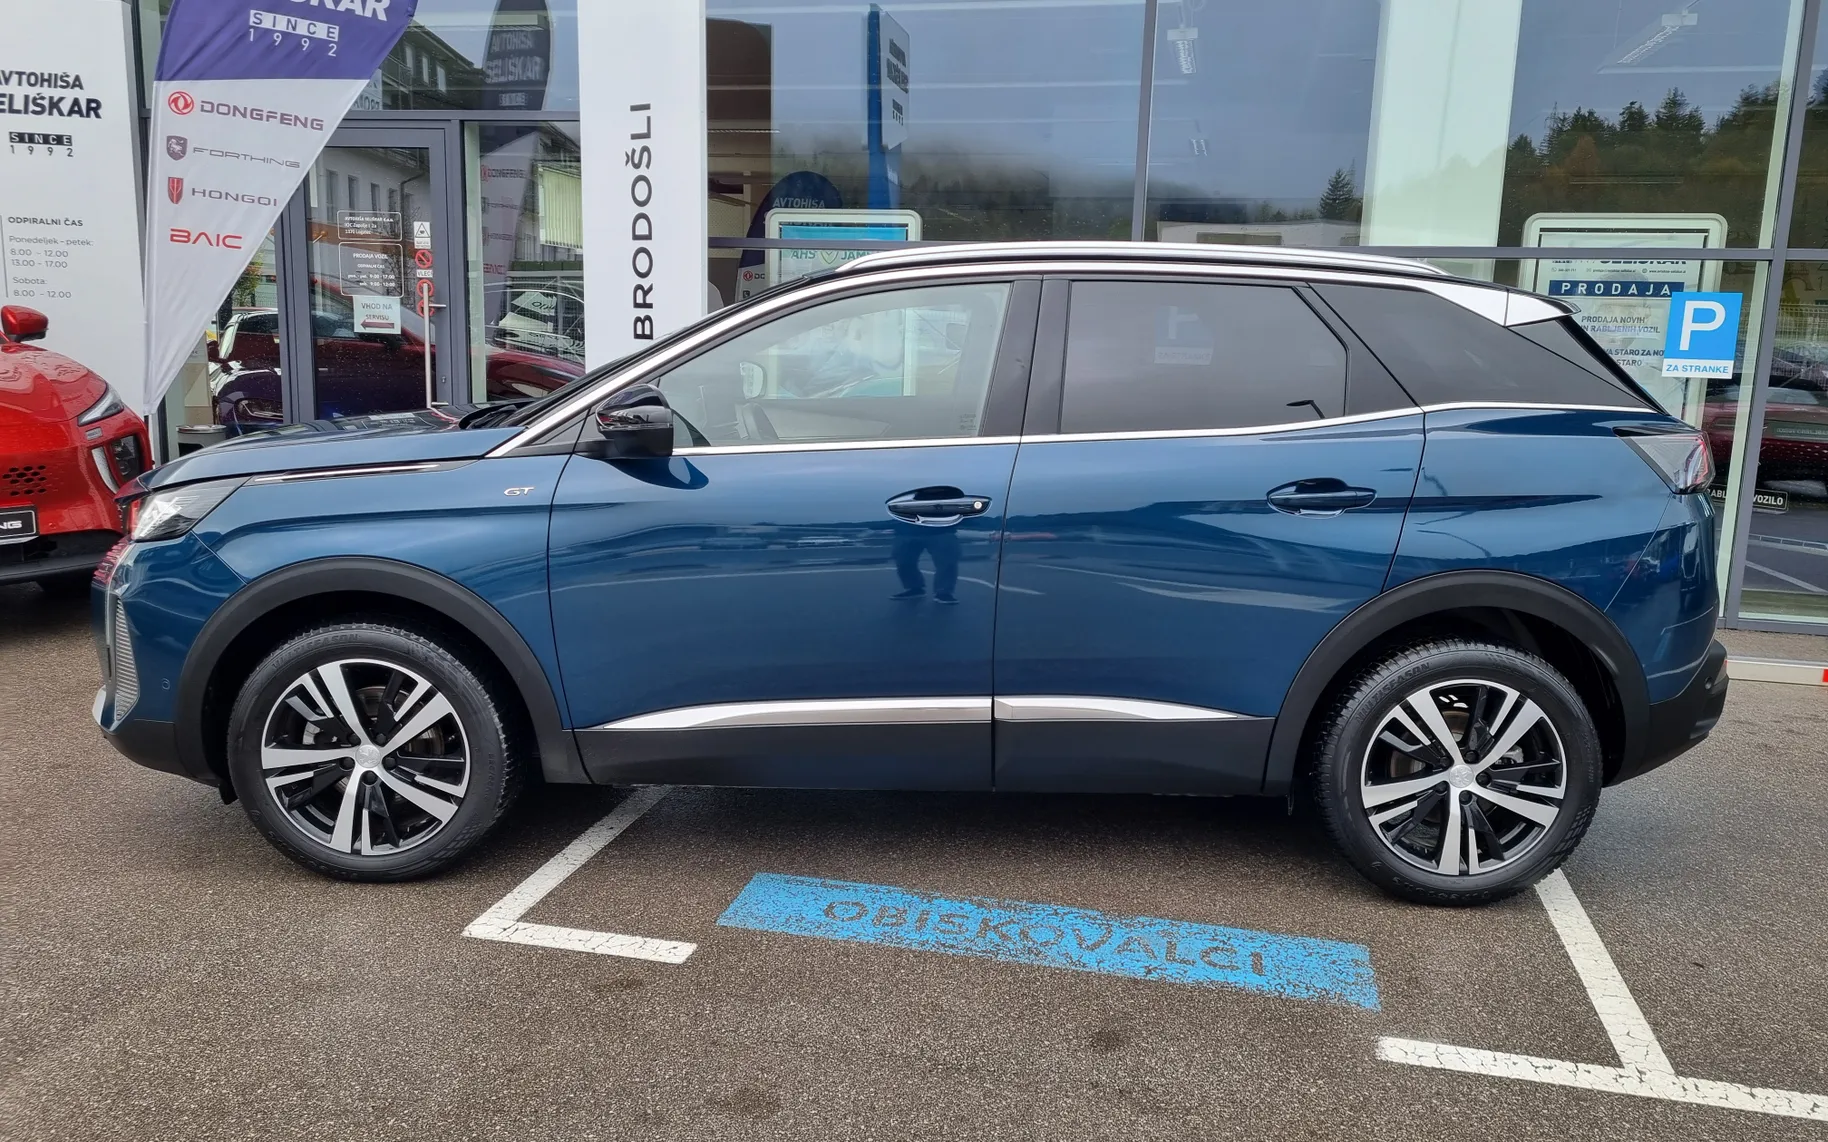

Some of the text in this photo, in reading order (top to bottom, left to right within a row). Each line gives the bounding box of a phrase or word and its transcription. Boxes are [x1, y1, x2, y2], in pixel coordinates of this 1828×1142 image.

[251, 12, 338, 40] SINCE
[249, 28, 338, 57] 1992
[200, 100, 324, 131] DONGFENG
[10, 132, 72, 146] SINCE
[10, 144, 74, 157] 1992
[192, 147, 300, 168] FORTHING
[191, 187, 277, 207] HONGQI
[7, 216, 84, 227] ODPIRALNI ČAS
[9, 235, 59, 245] Ponedeljek
[170, 228, 243, 250] BAIC
[10, 248, 32, 256] 8.00
[44, 249, 69, 258] 12.00
[11, 259, 35, 267] 13.00
[45, 260, 68, 269] 17.00
[13, 289, 35, 297] 8.00
[47, 290, 72, 299] 12.00
[1560, 282, 1671, 296] PRODAJA
[1581, 316, 1645, 324] PRODAJA NOVIH
[1679, 300, 1726, 351] P
[1590, 325, 1636, 333] RABLJENIH
[1638, 326, 1660, 334] VOZIL
[1614, 349, 1640, 357] STARO
[1666, 364, 1729, 374] ZA STRANKE
[504, 487, 535, 496] GT
[823, 900, 1264, 976] OBISKOVALCI
